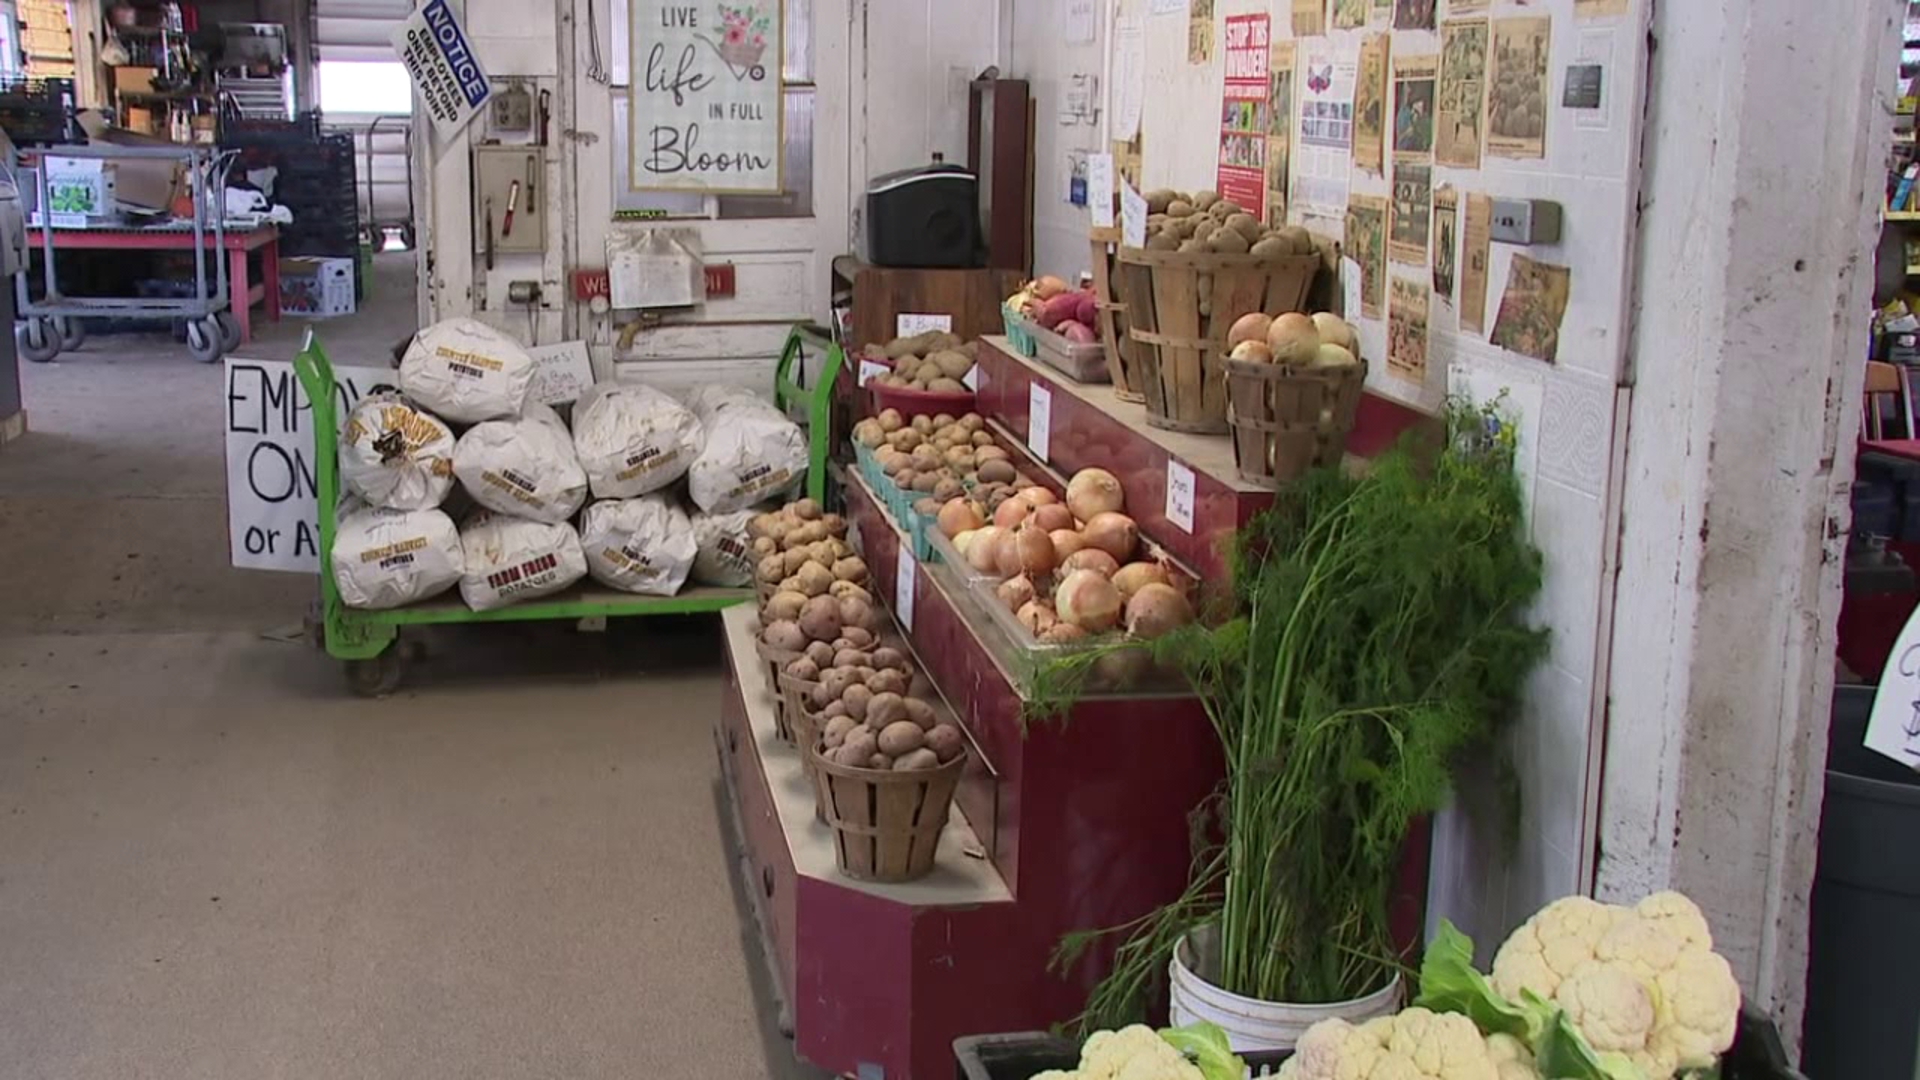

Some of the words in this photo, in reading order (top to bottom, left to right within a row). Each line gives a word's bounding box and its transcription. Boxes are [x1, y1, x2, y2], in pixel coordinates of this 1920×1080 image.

[661, 7, 698, 28] LIVE
[1226, 21, 1249, 48] STOP
[403, 46, 423, 81] THIS
[420, 81, 446, 121] POINT
[407, 29, 430, 64] ONLY
[426, 67, 458, 123] BEYOND
[418, 28, 463, 108] EMPLOYEES
[428, 5, 485, 100] NOTICE
[646, 42, 715, 107] life
[708, 103, 723, 120] IN
[730, 103, 764, 121] FULL
[643, 122, 772, 174] Bloom
[248, 441, 318, 503] ON
[244, 526, 281, 554] or
